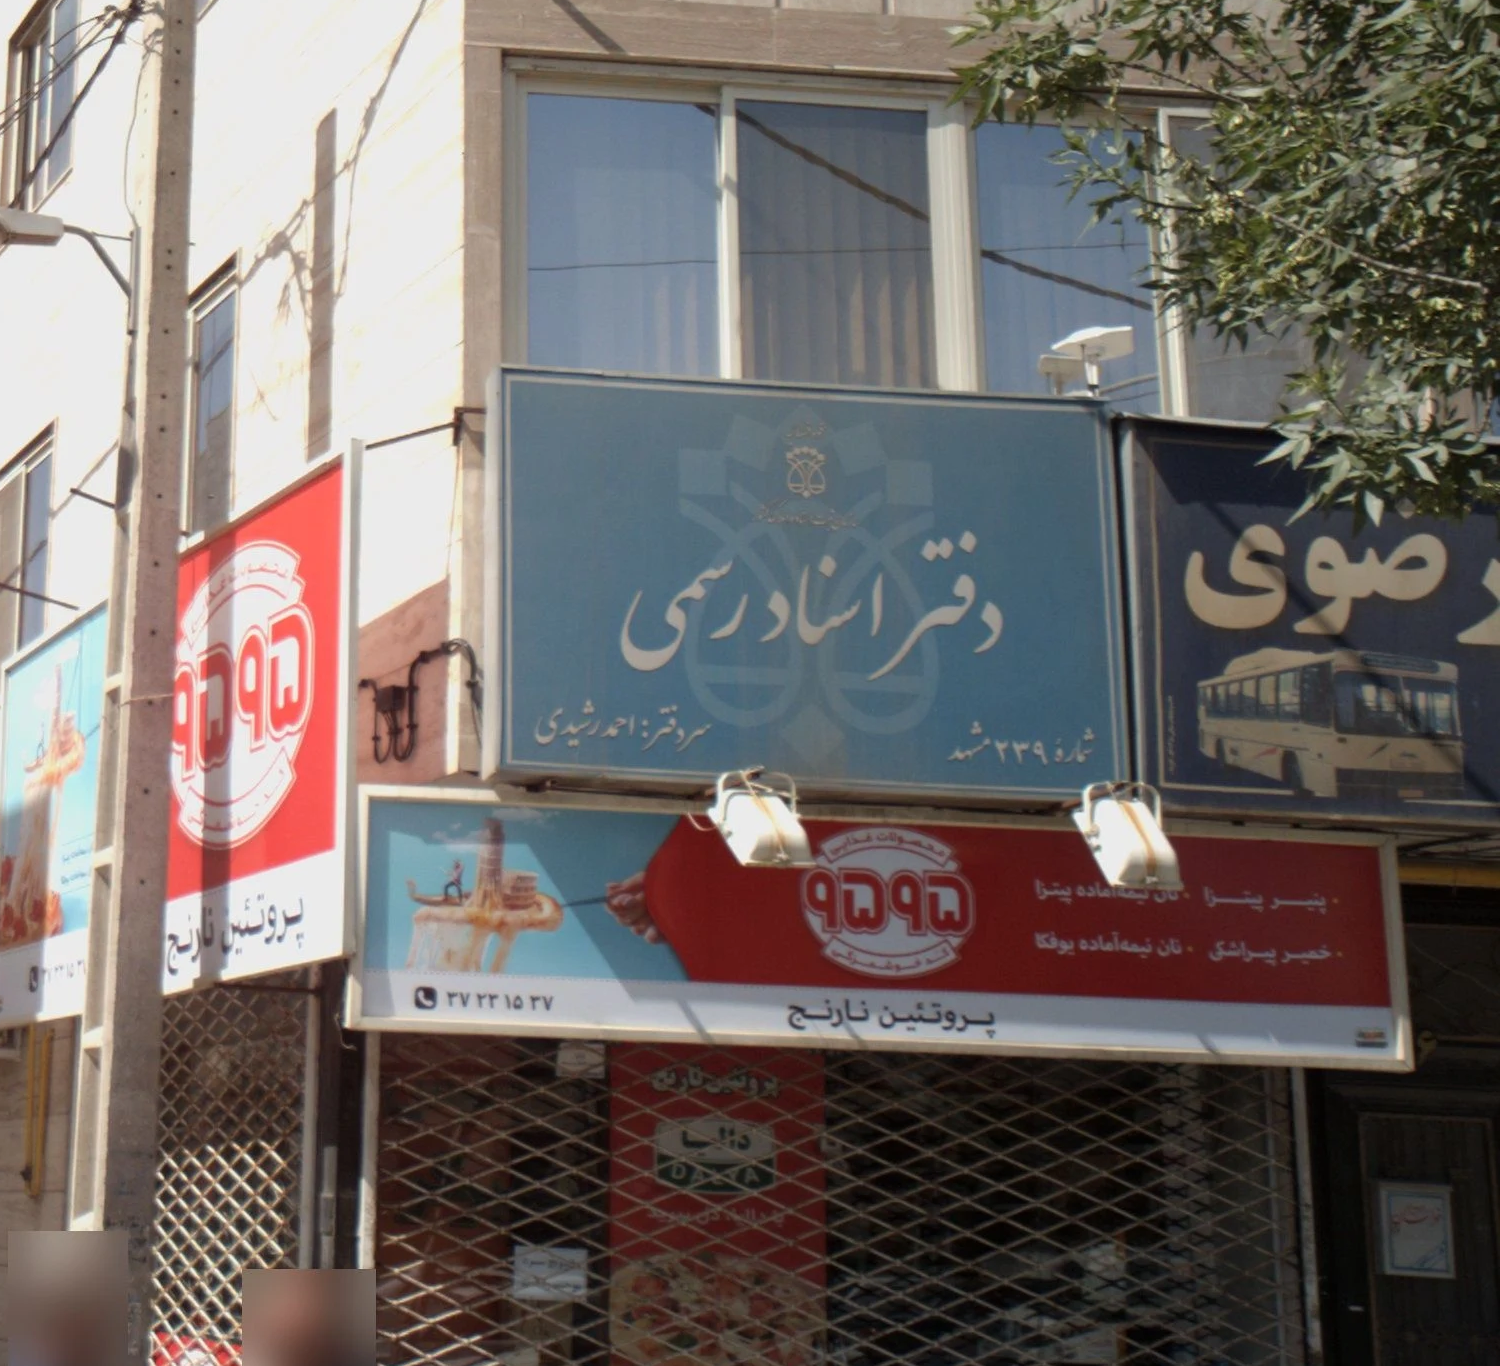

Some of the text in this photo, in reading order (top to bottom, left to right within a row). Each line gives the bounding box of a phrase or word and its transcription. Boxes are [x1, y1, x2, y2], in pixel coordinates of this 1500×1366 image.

[621, 530, 1003, 680] دفتر اسناد رسمی
[534, 699, 601, 747] رشیدی
[601, 714, 636, 738] احمد
[947, 720, 992, 762] مشهد
[1033, 878, 1072, 906] پیتزا
[1202, 885, 1328, 915] پنیر پیتزا
[167, 893, 306, 976] پروتئین نارنج
[1156, 936, 1184, 957] نان
[1208, 939, 1332, 967] خمیر پیراشکی
[504, 993, 525, 1011] ۱۵
[787, 998, 996, 1039] پروتئین نارنج
